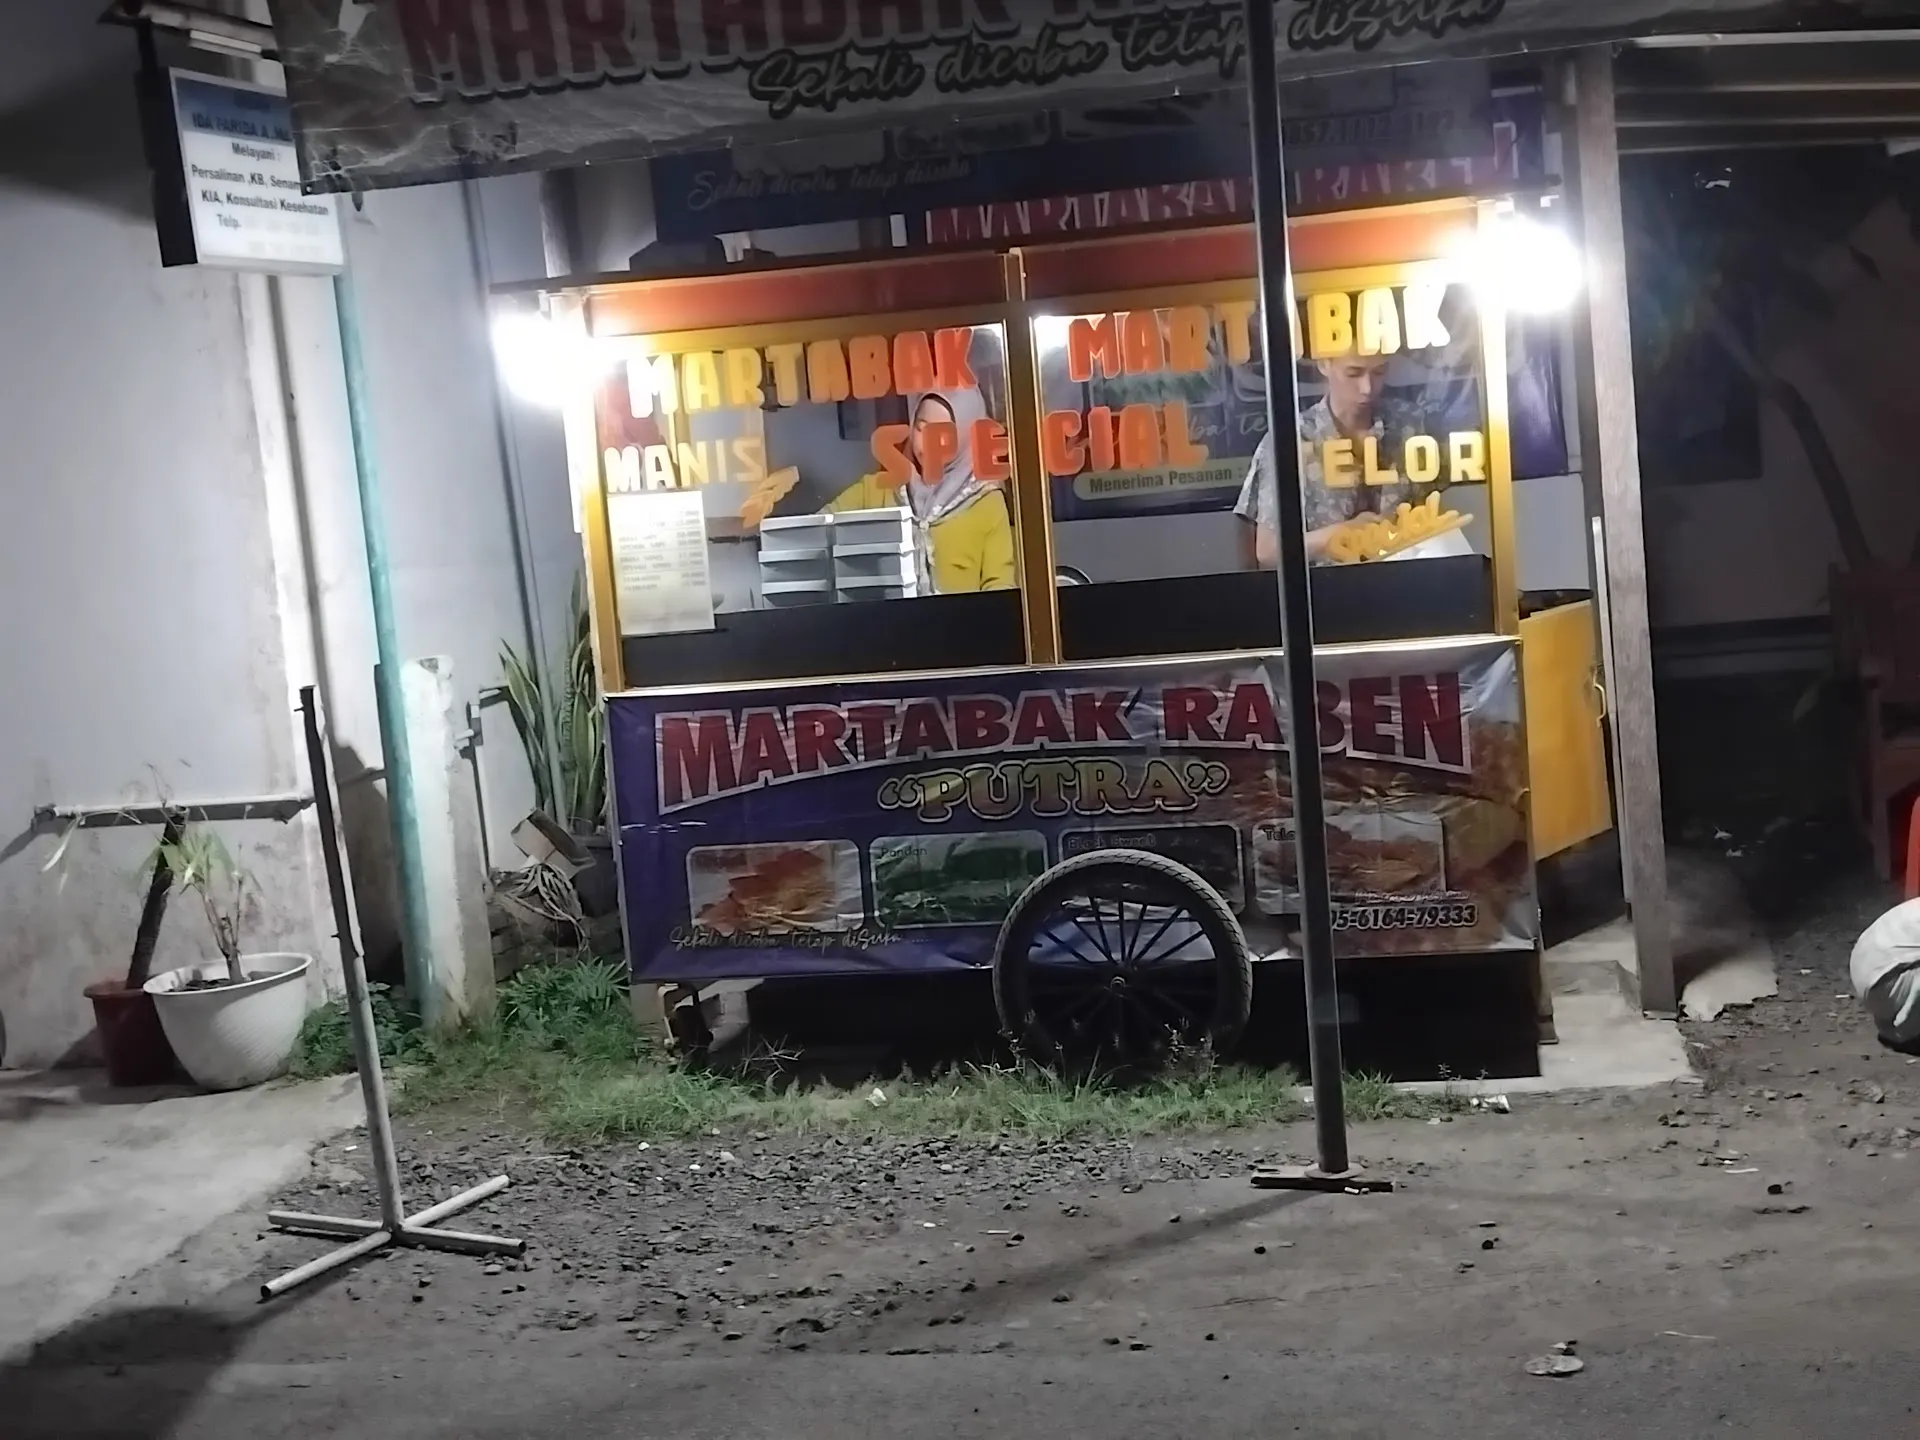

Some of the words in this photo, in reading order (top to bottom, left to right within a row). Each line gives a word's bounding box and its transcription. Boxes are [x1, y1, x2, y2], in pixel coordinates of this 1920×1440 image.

[398, 0, 1022, 105] MARTA
[749, 38, 925, 118] Sekali
[935, 22, 1109, 93] dicoba
[232, 143, 276, 161] Melayani
[191, 164, 245, 184] Persalinan
[226, 193, 278, 210] Konsultasi
[280, 198, 329, 216] Kesehatan
[1069, 284, 1452, 382] MARTBAK
[626, 327, 977, 419] MARTABAK
[603, 437, 764, 493] MANIS
[870, 402, 1209, 489] SPECIAL
[1300, 431, 1487, 488] ELOR
[1089, 470, 1165, 494] Menerima
[1168, 466, 1234, 486] Pesanan
[655, 688, 1137, 815] MARTABAK
[880, 847, 928, 858] Pandan
[1263, 828, 1297, 842] Telo
[1332, 904, 1478, 931] 5-6164-79333
[669, 926, 722, 951] Sekali
[789, 928, 837, 954] tetap
